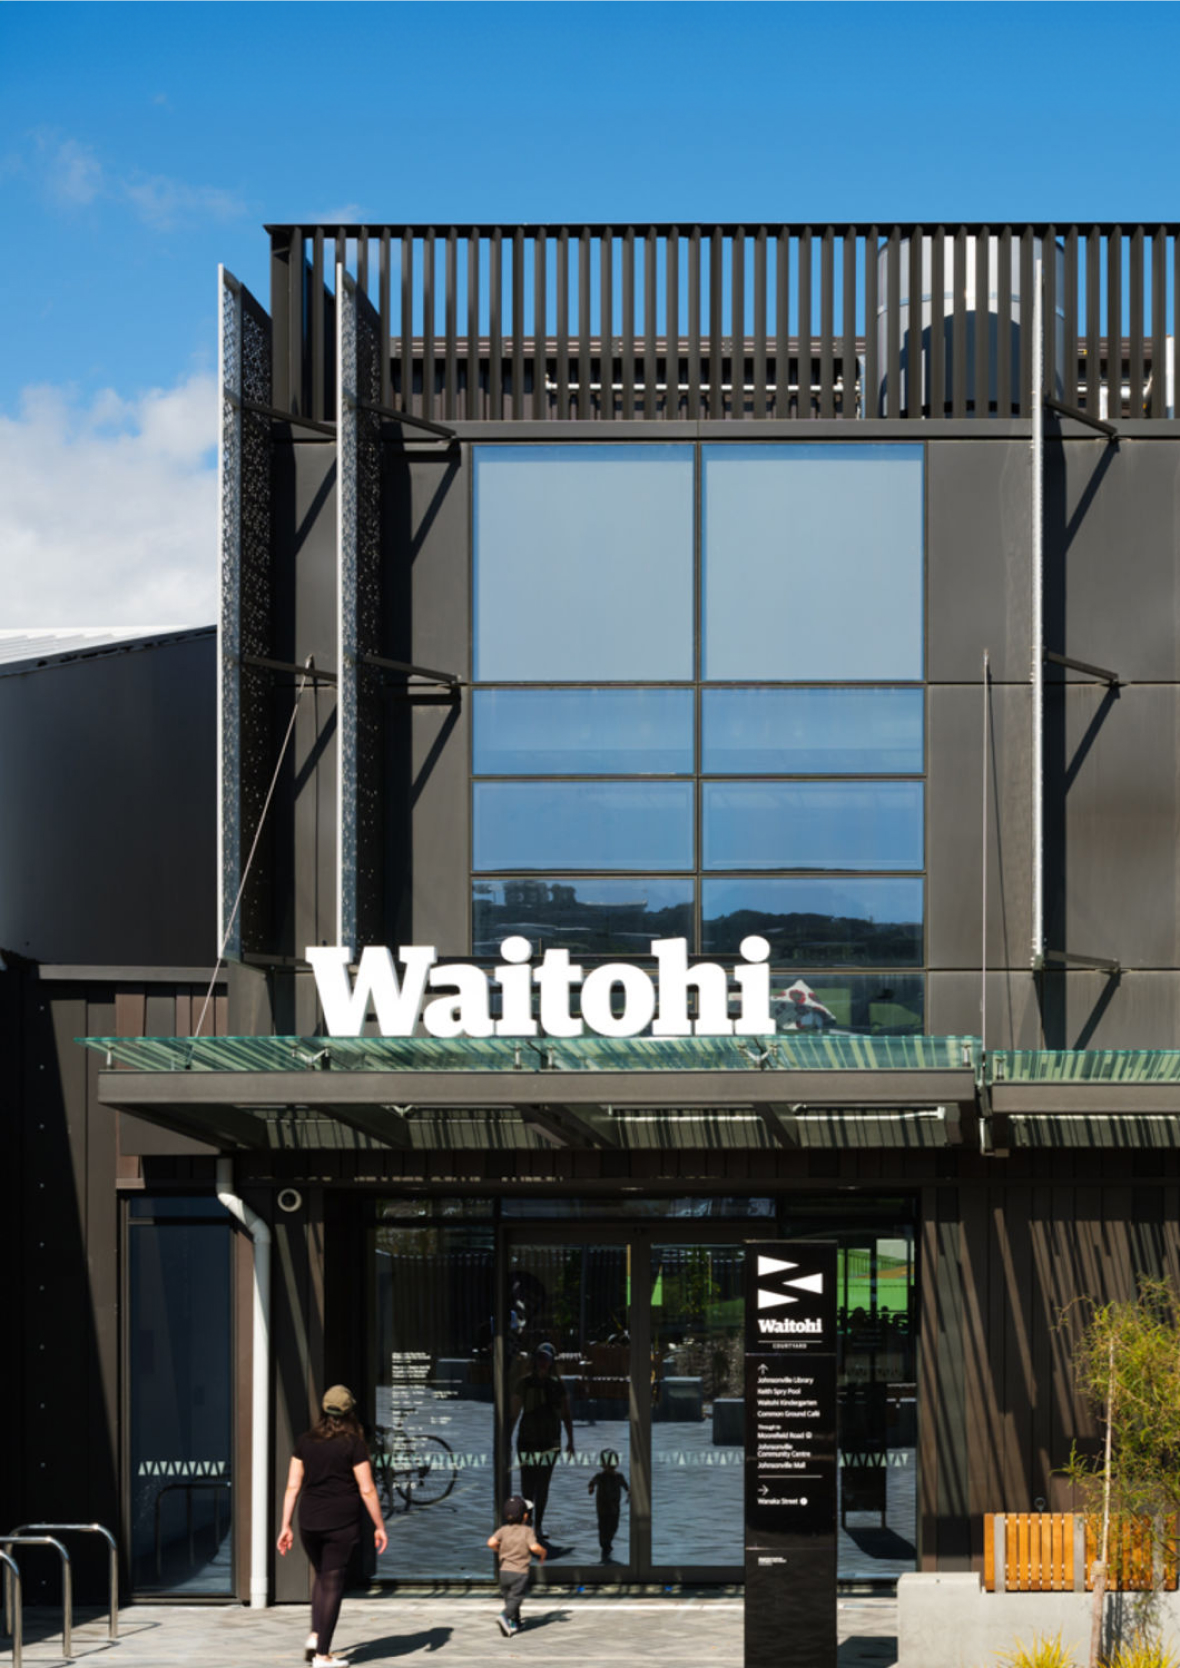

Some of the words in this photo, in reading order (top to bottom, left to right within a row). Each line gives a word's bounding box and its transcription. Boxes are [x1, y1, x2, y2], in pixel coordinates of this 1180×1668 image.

[305, 935, 777, 1038] Waitohi
[758, 1318, 823, 1333] Waitohi
[794, 1377, 814, 1385] Library
[774, 1388, 787, 1396] Spry
[757, 1399, 779, 1407] Waitohi
[780, 1399, 817, 1407] Kindergarten
[757, 1451, 790, 1459] Community
[757, 1461, 792, 1469] Johnsonville
[793, 1461, 806, 1469] Mall
[757, 1497, 780, 1505] Wanaka
[781, 1497, 798, 1505] Street
